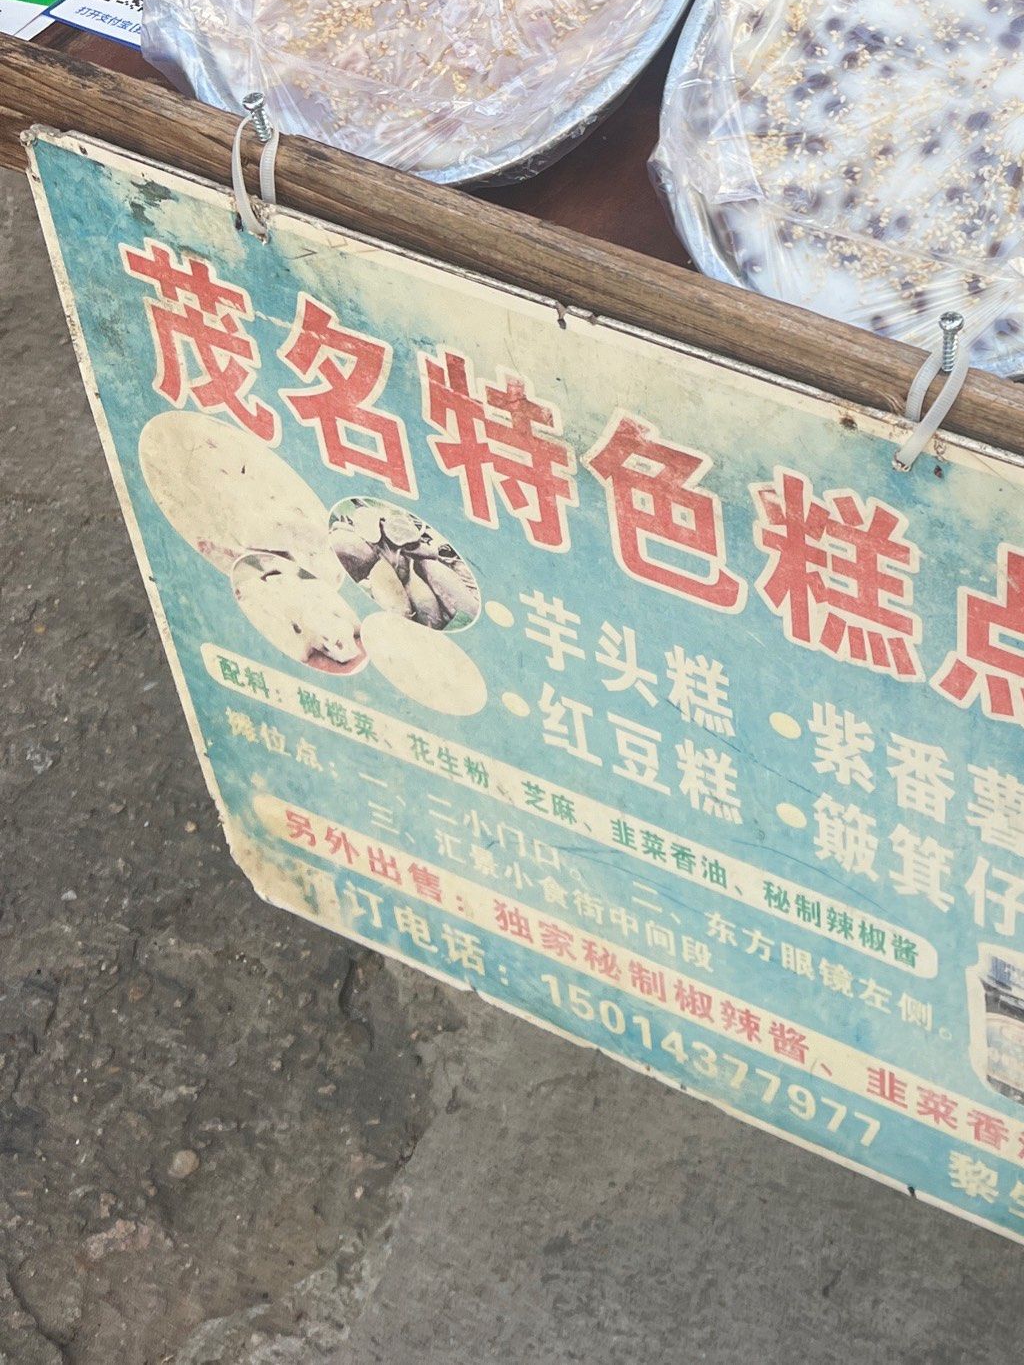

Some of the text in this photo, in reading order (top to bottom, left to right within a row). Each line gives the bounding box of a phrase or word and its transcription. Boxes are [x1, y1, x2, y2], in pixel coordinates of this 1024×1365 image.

[518, 590, 736, 738] 芋头糕
[537, 681, 744, 825] 红豆糕
